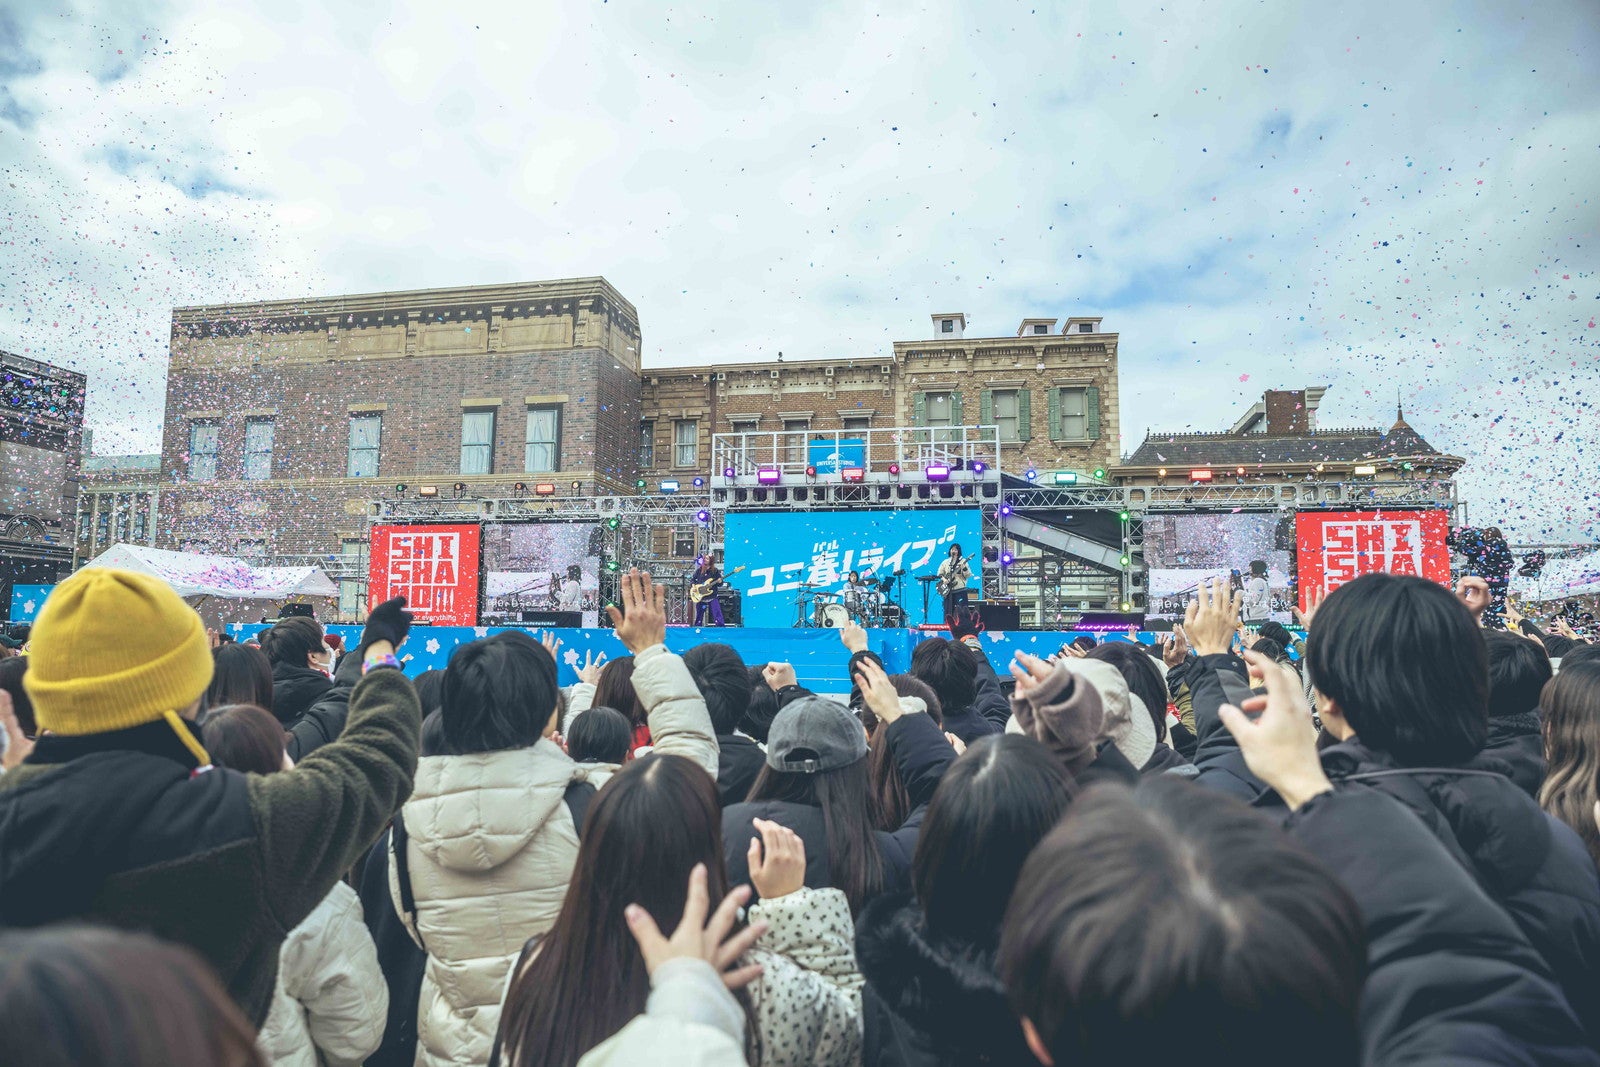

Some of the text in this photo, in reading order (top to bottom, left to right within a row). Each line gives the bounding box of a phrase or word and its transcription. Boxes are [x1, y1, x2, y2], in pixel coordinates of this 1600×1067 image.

[391, 536, 454, 559] SHI
[1326, 525, 1413, 552] SHI
[390, 561, 455, 583] SHA
[1327, 554, 1417, 580] SHA
[421, 614, 457, 622] everything
